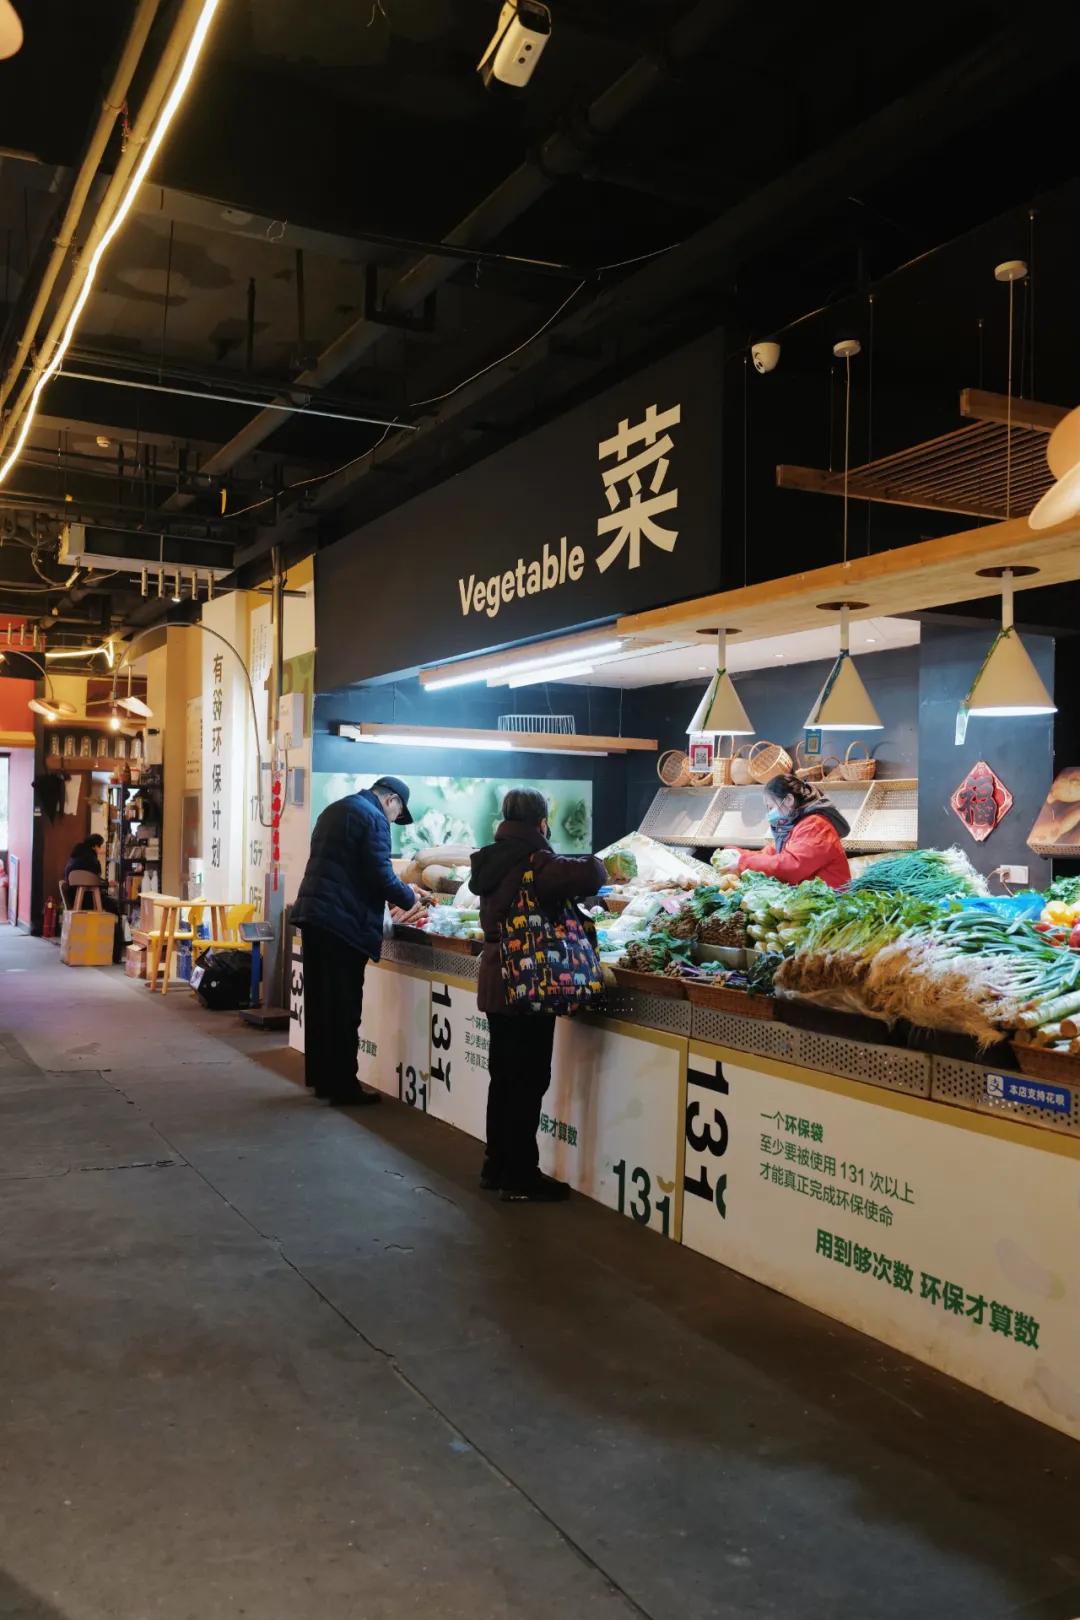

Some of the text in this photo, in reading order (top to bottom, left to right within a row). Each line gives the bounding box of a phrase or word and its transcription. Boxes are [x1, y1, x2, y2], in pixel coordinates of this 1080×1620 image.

[595, 402, 681, 574] 菜
[458, 535, 585, 619] Vegetable
[957, 774, 998, 828] 福
[431, 983, 452, 1085] 131
[465, 1015, 491, 1031] 一个环保
[395, 1061, 427, 1112] 131
[684, 1060, 729, 1203] 131
[759, 1110, 825, 1144] 一个环保袋
[613, 1159, 670, 1238] 131
[759, 1133, 915, 1205] 至少要被使用 131 次以上
[759, 1160, 894, 1228] 才能真正完成环保使命
[815, 1228, 1040, 1350] 用到够次数 环保才算数
